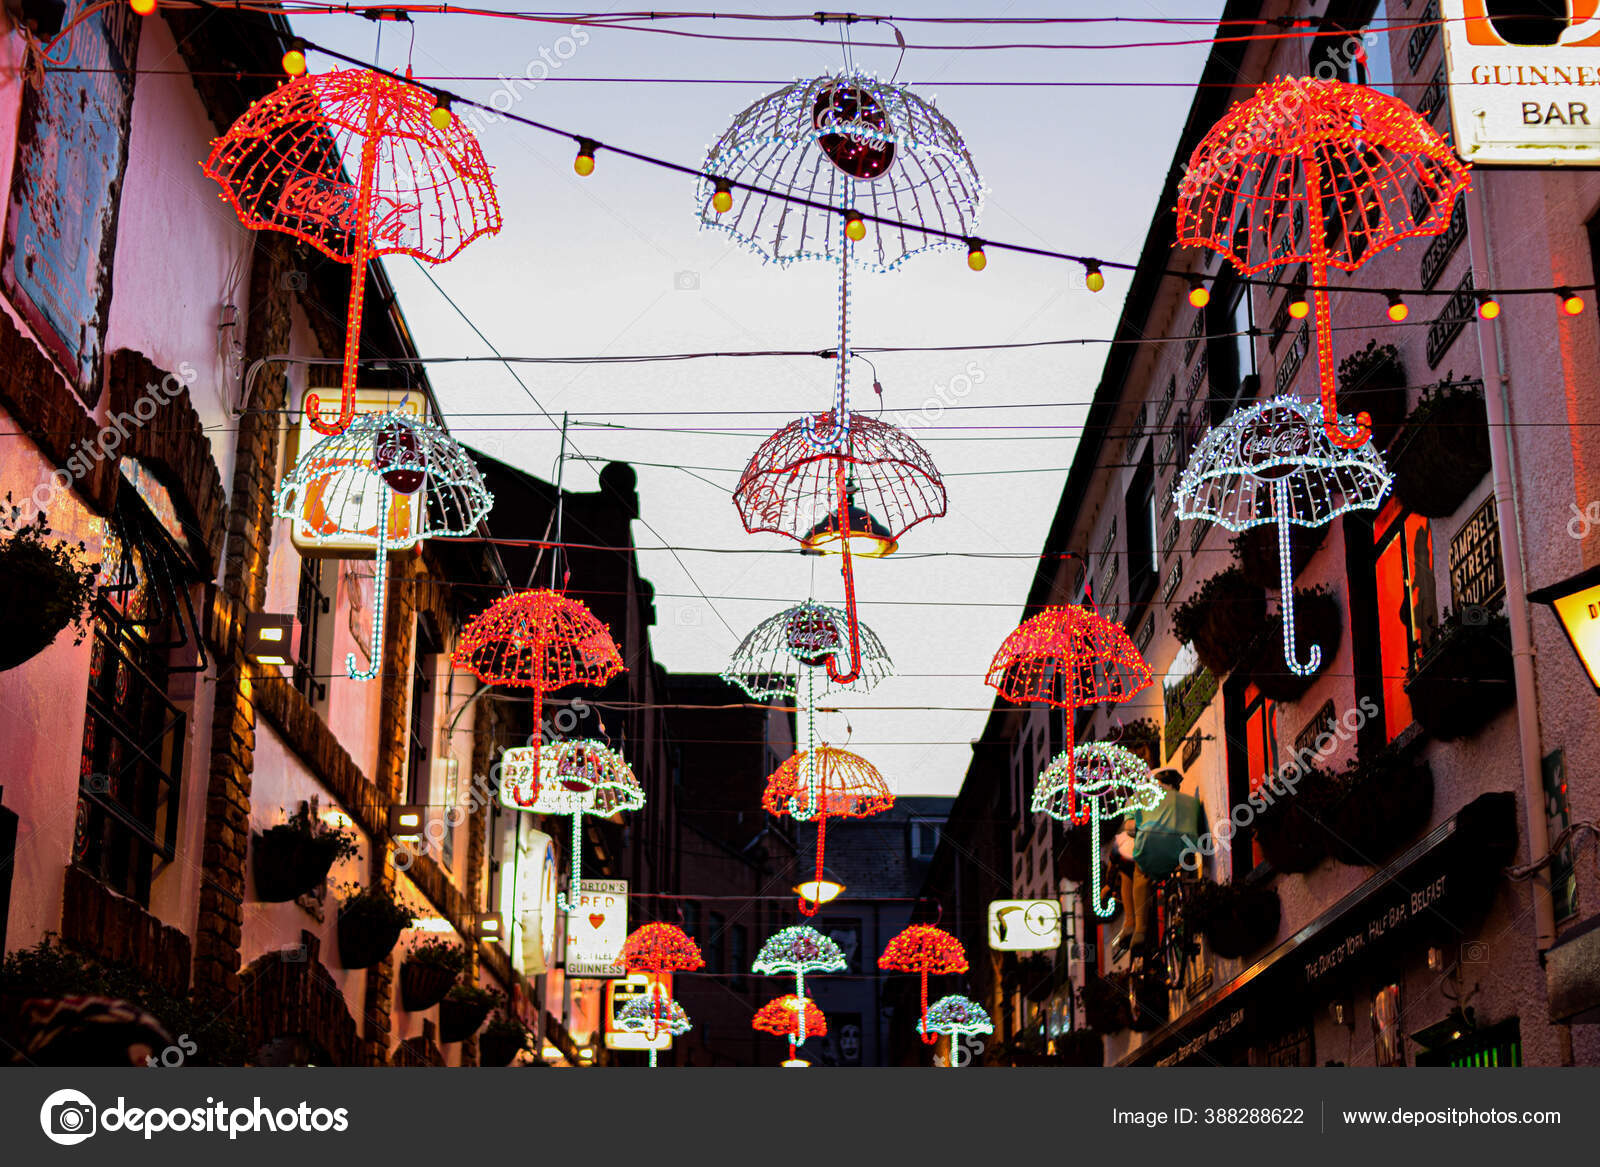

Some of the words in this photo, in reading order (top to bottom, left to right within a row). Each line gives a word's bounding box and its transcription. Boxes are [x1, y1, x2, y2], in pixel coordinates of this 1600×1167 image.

[1472, 65, 1600, 86] GUINNE
[1521, 102, 1590, 125] BAR
[1448, 499, 1498, 570] CAMPBELL
[1455, 532, 1496, 593] STREET
[573, 882, 625, 892] ORTON'S
[1411, 875, 1448, 916] BELFAST
[568, 963, 623, 975] GUINNESS
